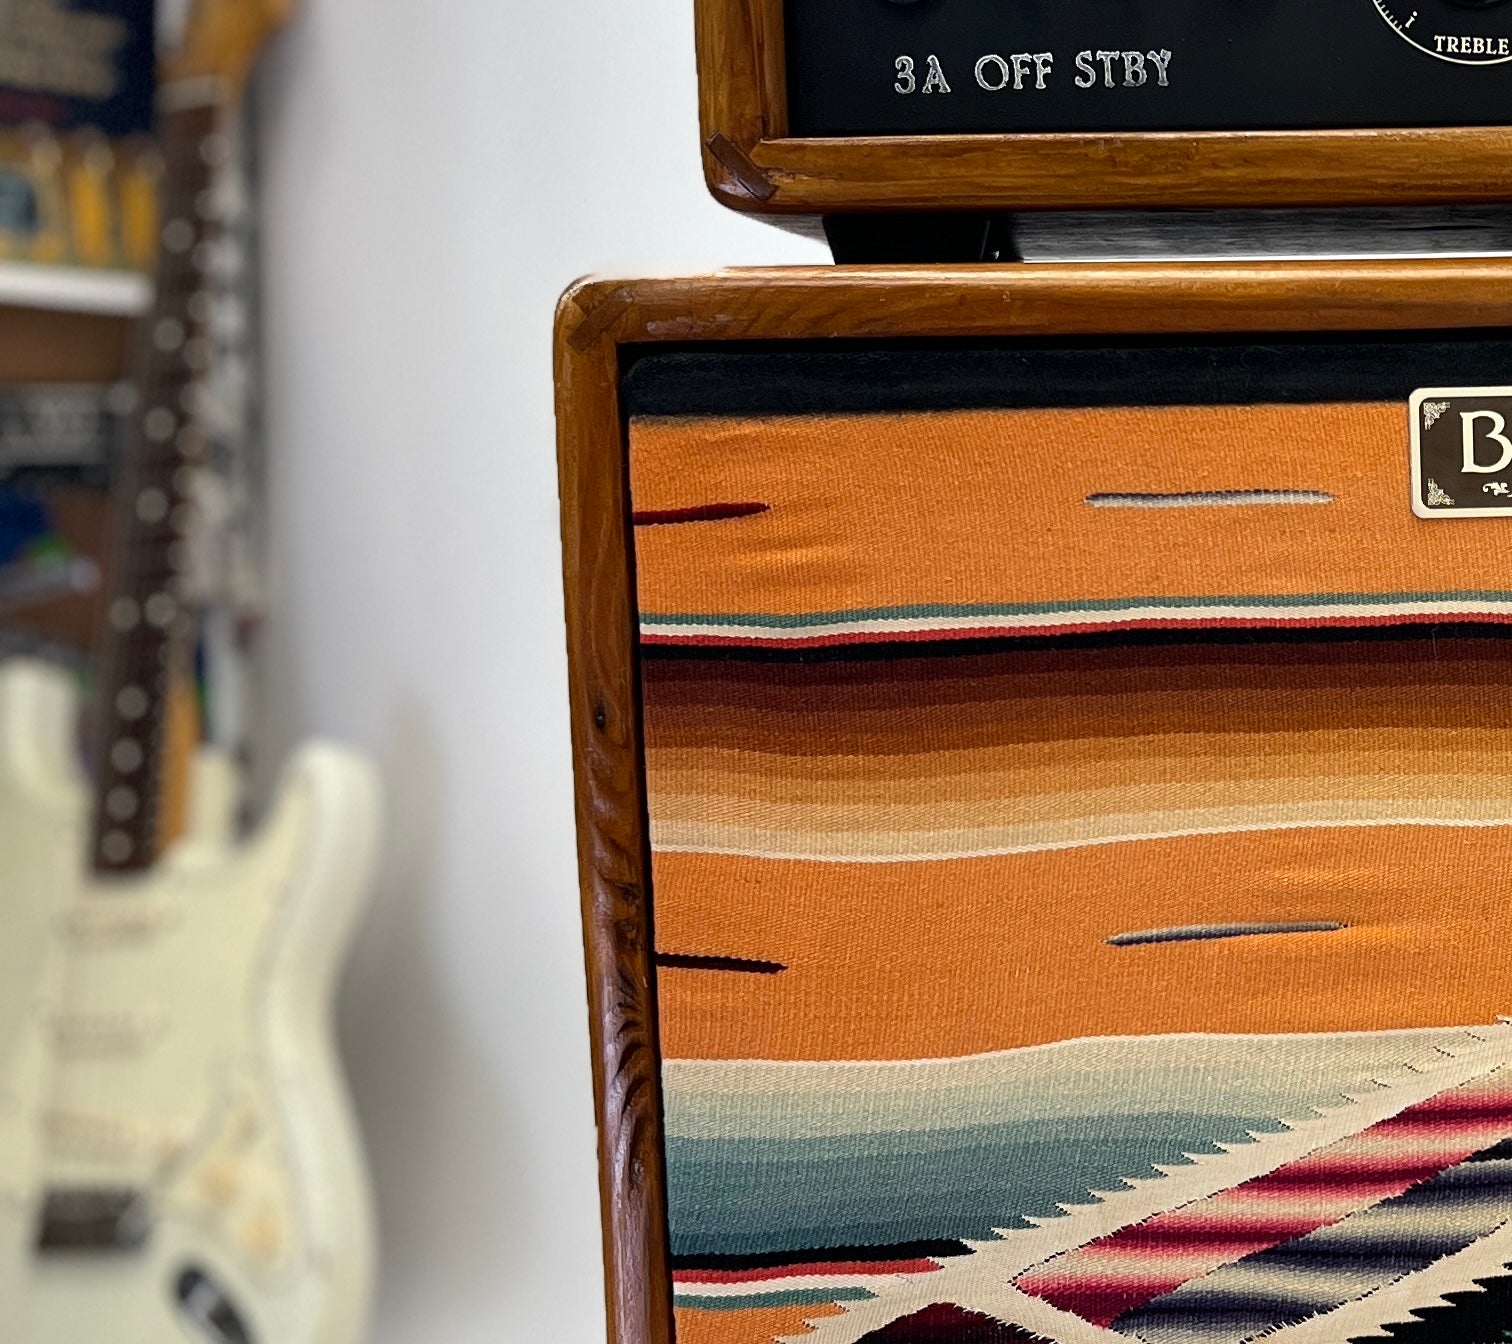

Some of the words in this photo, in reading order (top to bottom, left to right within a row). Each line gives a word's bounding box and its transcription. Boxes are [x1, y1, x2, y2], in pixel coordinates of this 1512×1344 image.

[1434, 35, 1510, 56] TREBLE
[894, 54, 951, 95] 3A
[974, 52, 1053, 91] OFF
[1074, 49, 1172, 89] STBY
